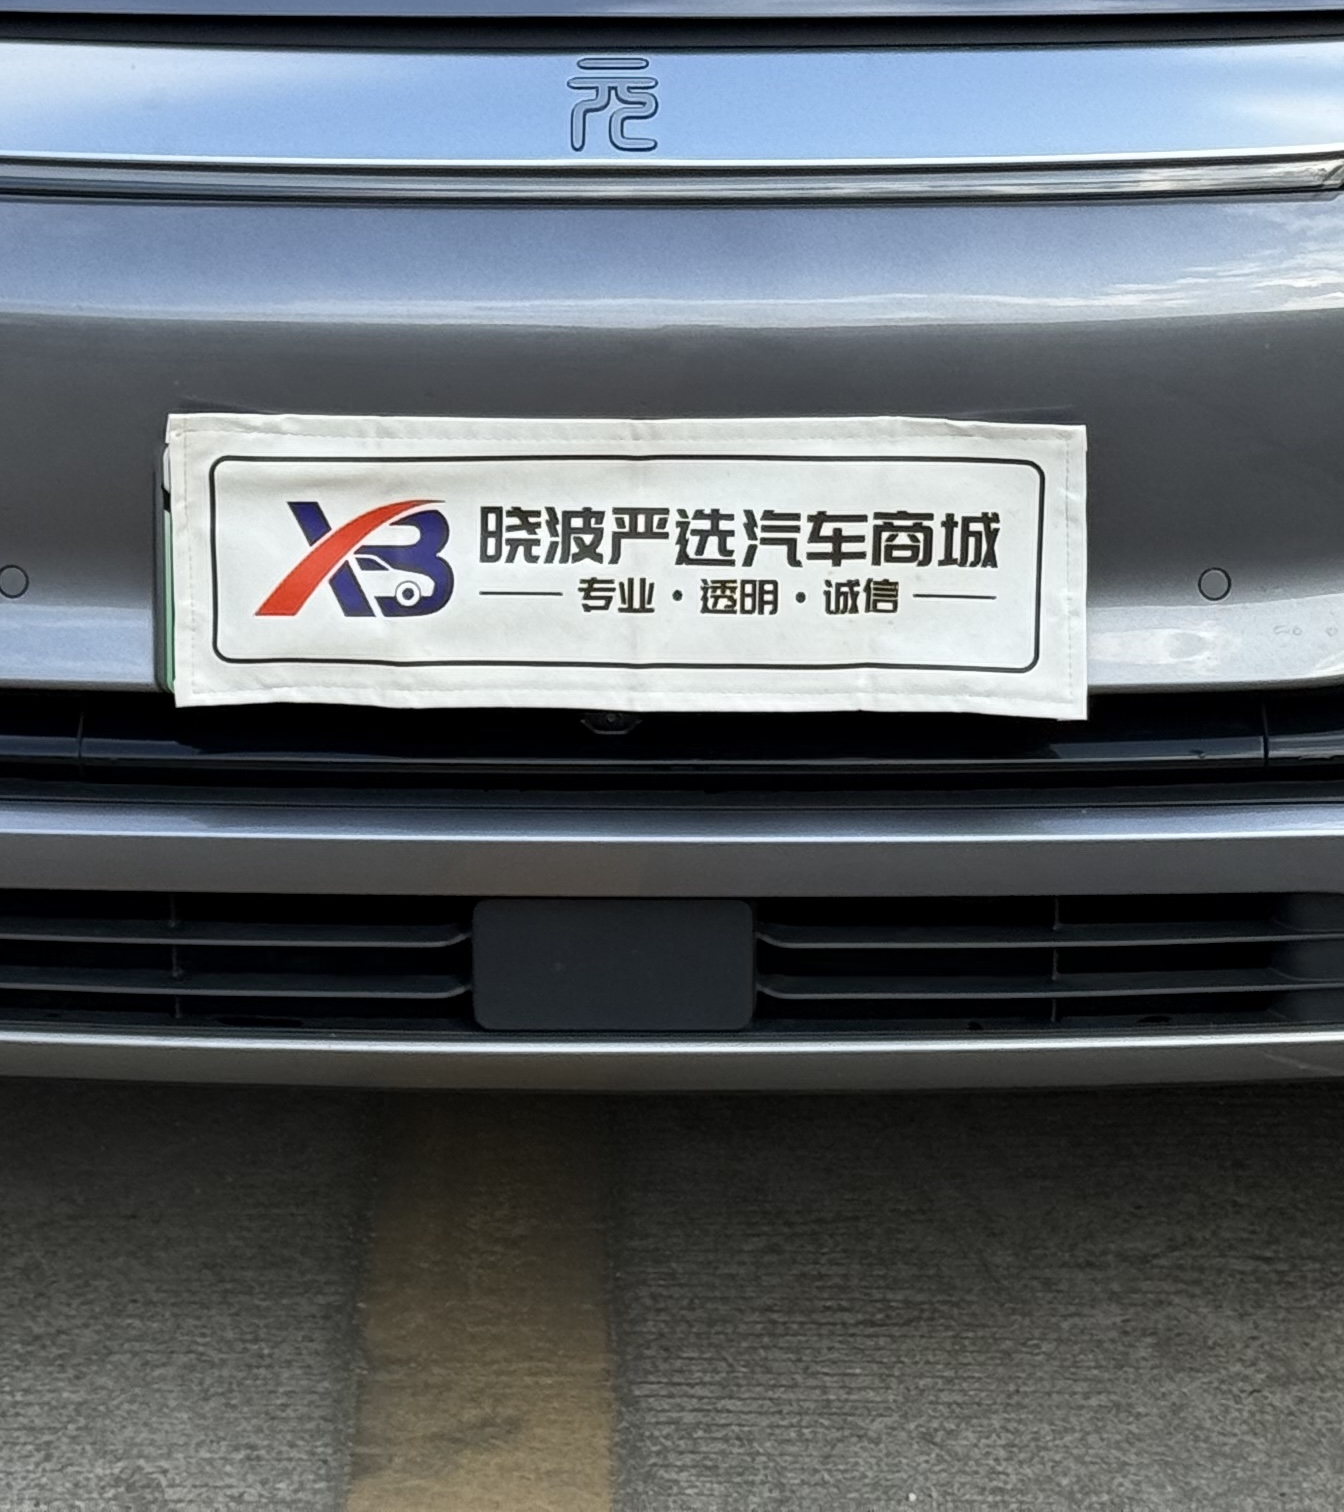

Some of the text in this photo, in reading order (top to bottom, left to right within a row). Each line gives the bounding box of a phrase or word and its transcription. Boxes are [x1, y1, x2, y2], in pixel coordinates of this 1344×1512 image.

[480, 506, 1000, 568] 晓波严选汽车商城
